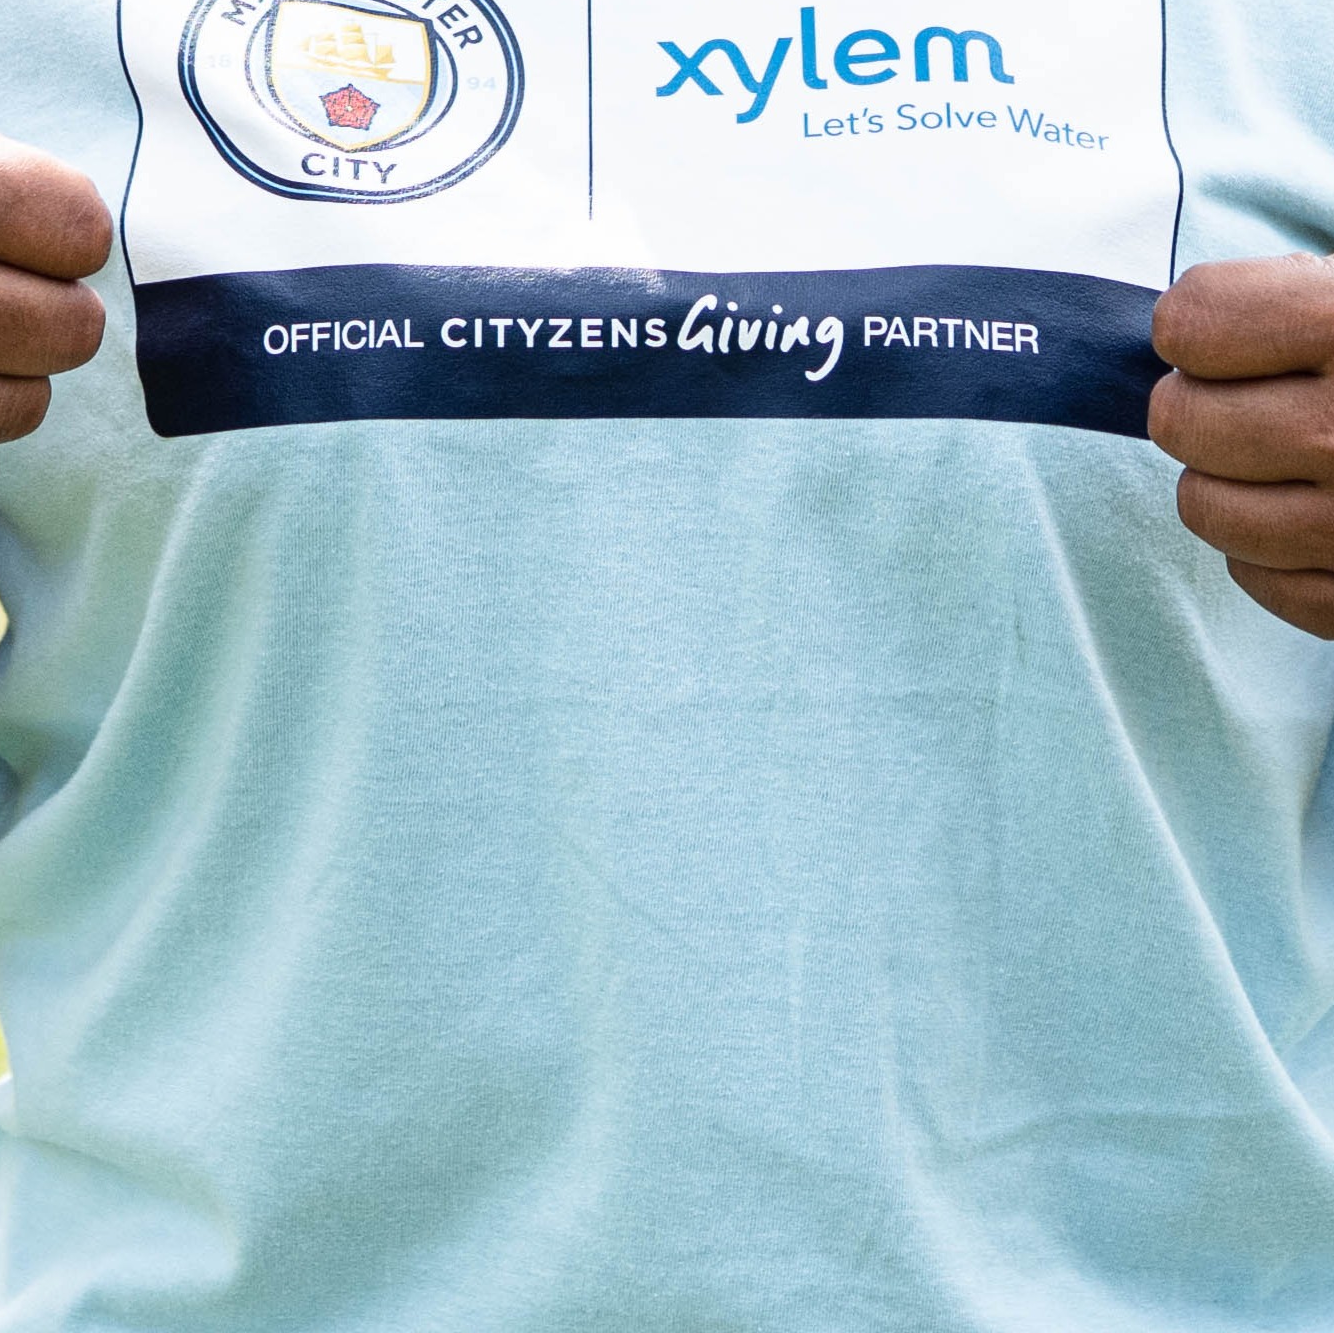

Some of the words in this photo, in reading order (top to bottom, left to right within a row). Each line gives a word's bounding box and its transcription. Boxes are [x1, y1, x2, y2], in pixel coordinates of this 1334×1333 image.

[466, 75, 497, 92] 94
[655, 6, 1016, 124] xylem
[803, 107, 884, 138] Let's
[897, 102, 997, 131] Solve
[1006, 105, 1110, 151] Water
[301, 152, 397, 184] CITY
[262, 318, 425, 355] OFFICIAL
[440, 316, 668, 349] CITYZENS
[676, 293, 845, 382] Giving
[863, 315, 1041, 354] PARTNER
